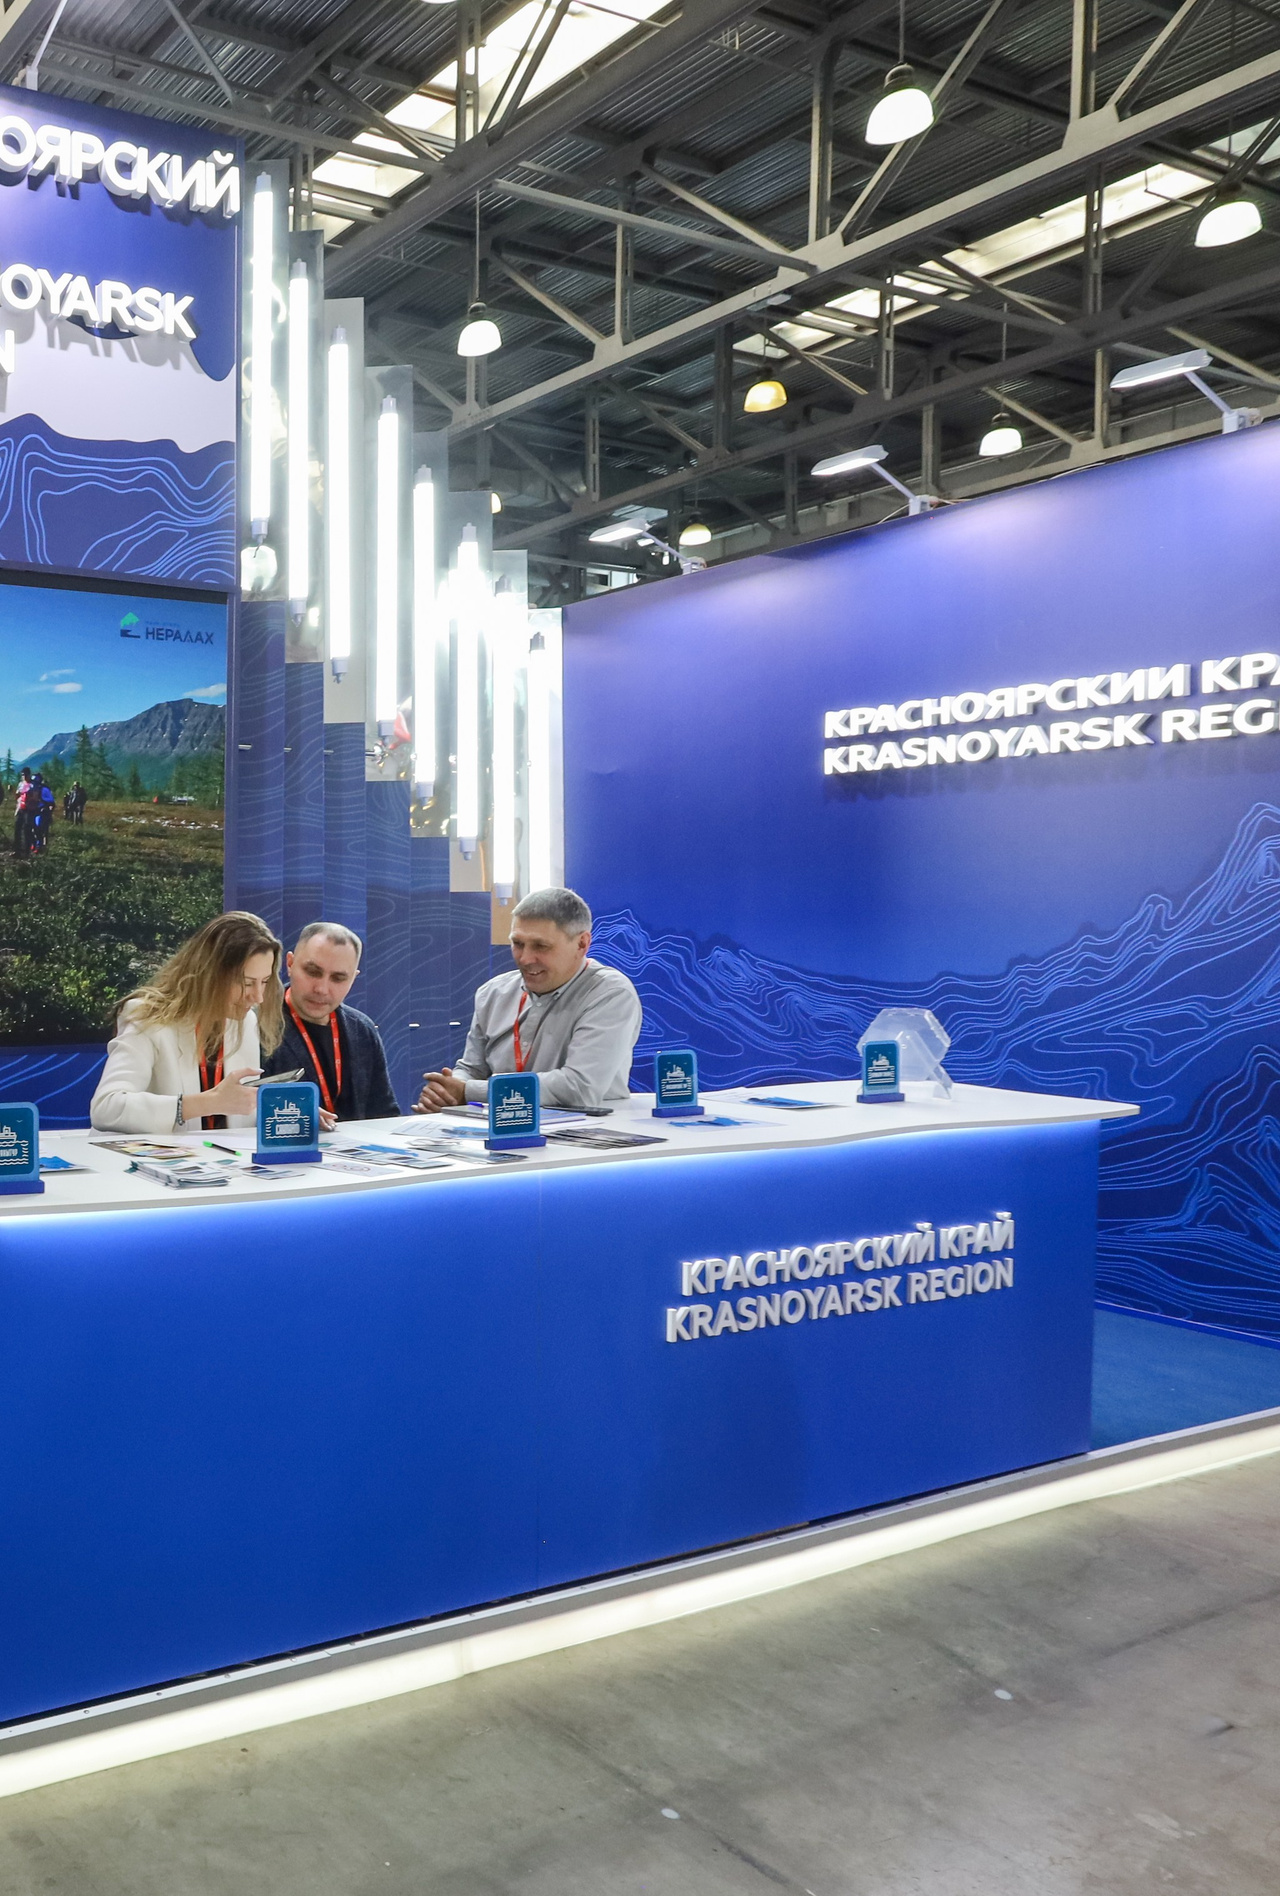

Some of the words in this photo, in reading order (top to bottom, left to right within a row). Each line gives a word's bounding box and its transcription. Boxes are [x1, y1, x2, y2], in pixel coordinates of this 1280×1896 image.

[1201, 652, 1280, 694] КР
[824, 712, 1155, 775] KRASNOYARSK
[1161, 698, 1280, 743] REG
[681, 1221, 935, 1296] КРАСНОЯРСКИЙ
[939, 1211, 1014, 1260] КРАЙ
[665, 1275, 903, 1343] KRASNOYARSK
[907, 1257, 1014, 1305] REGION
